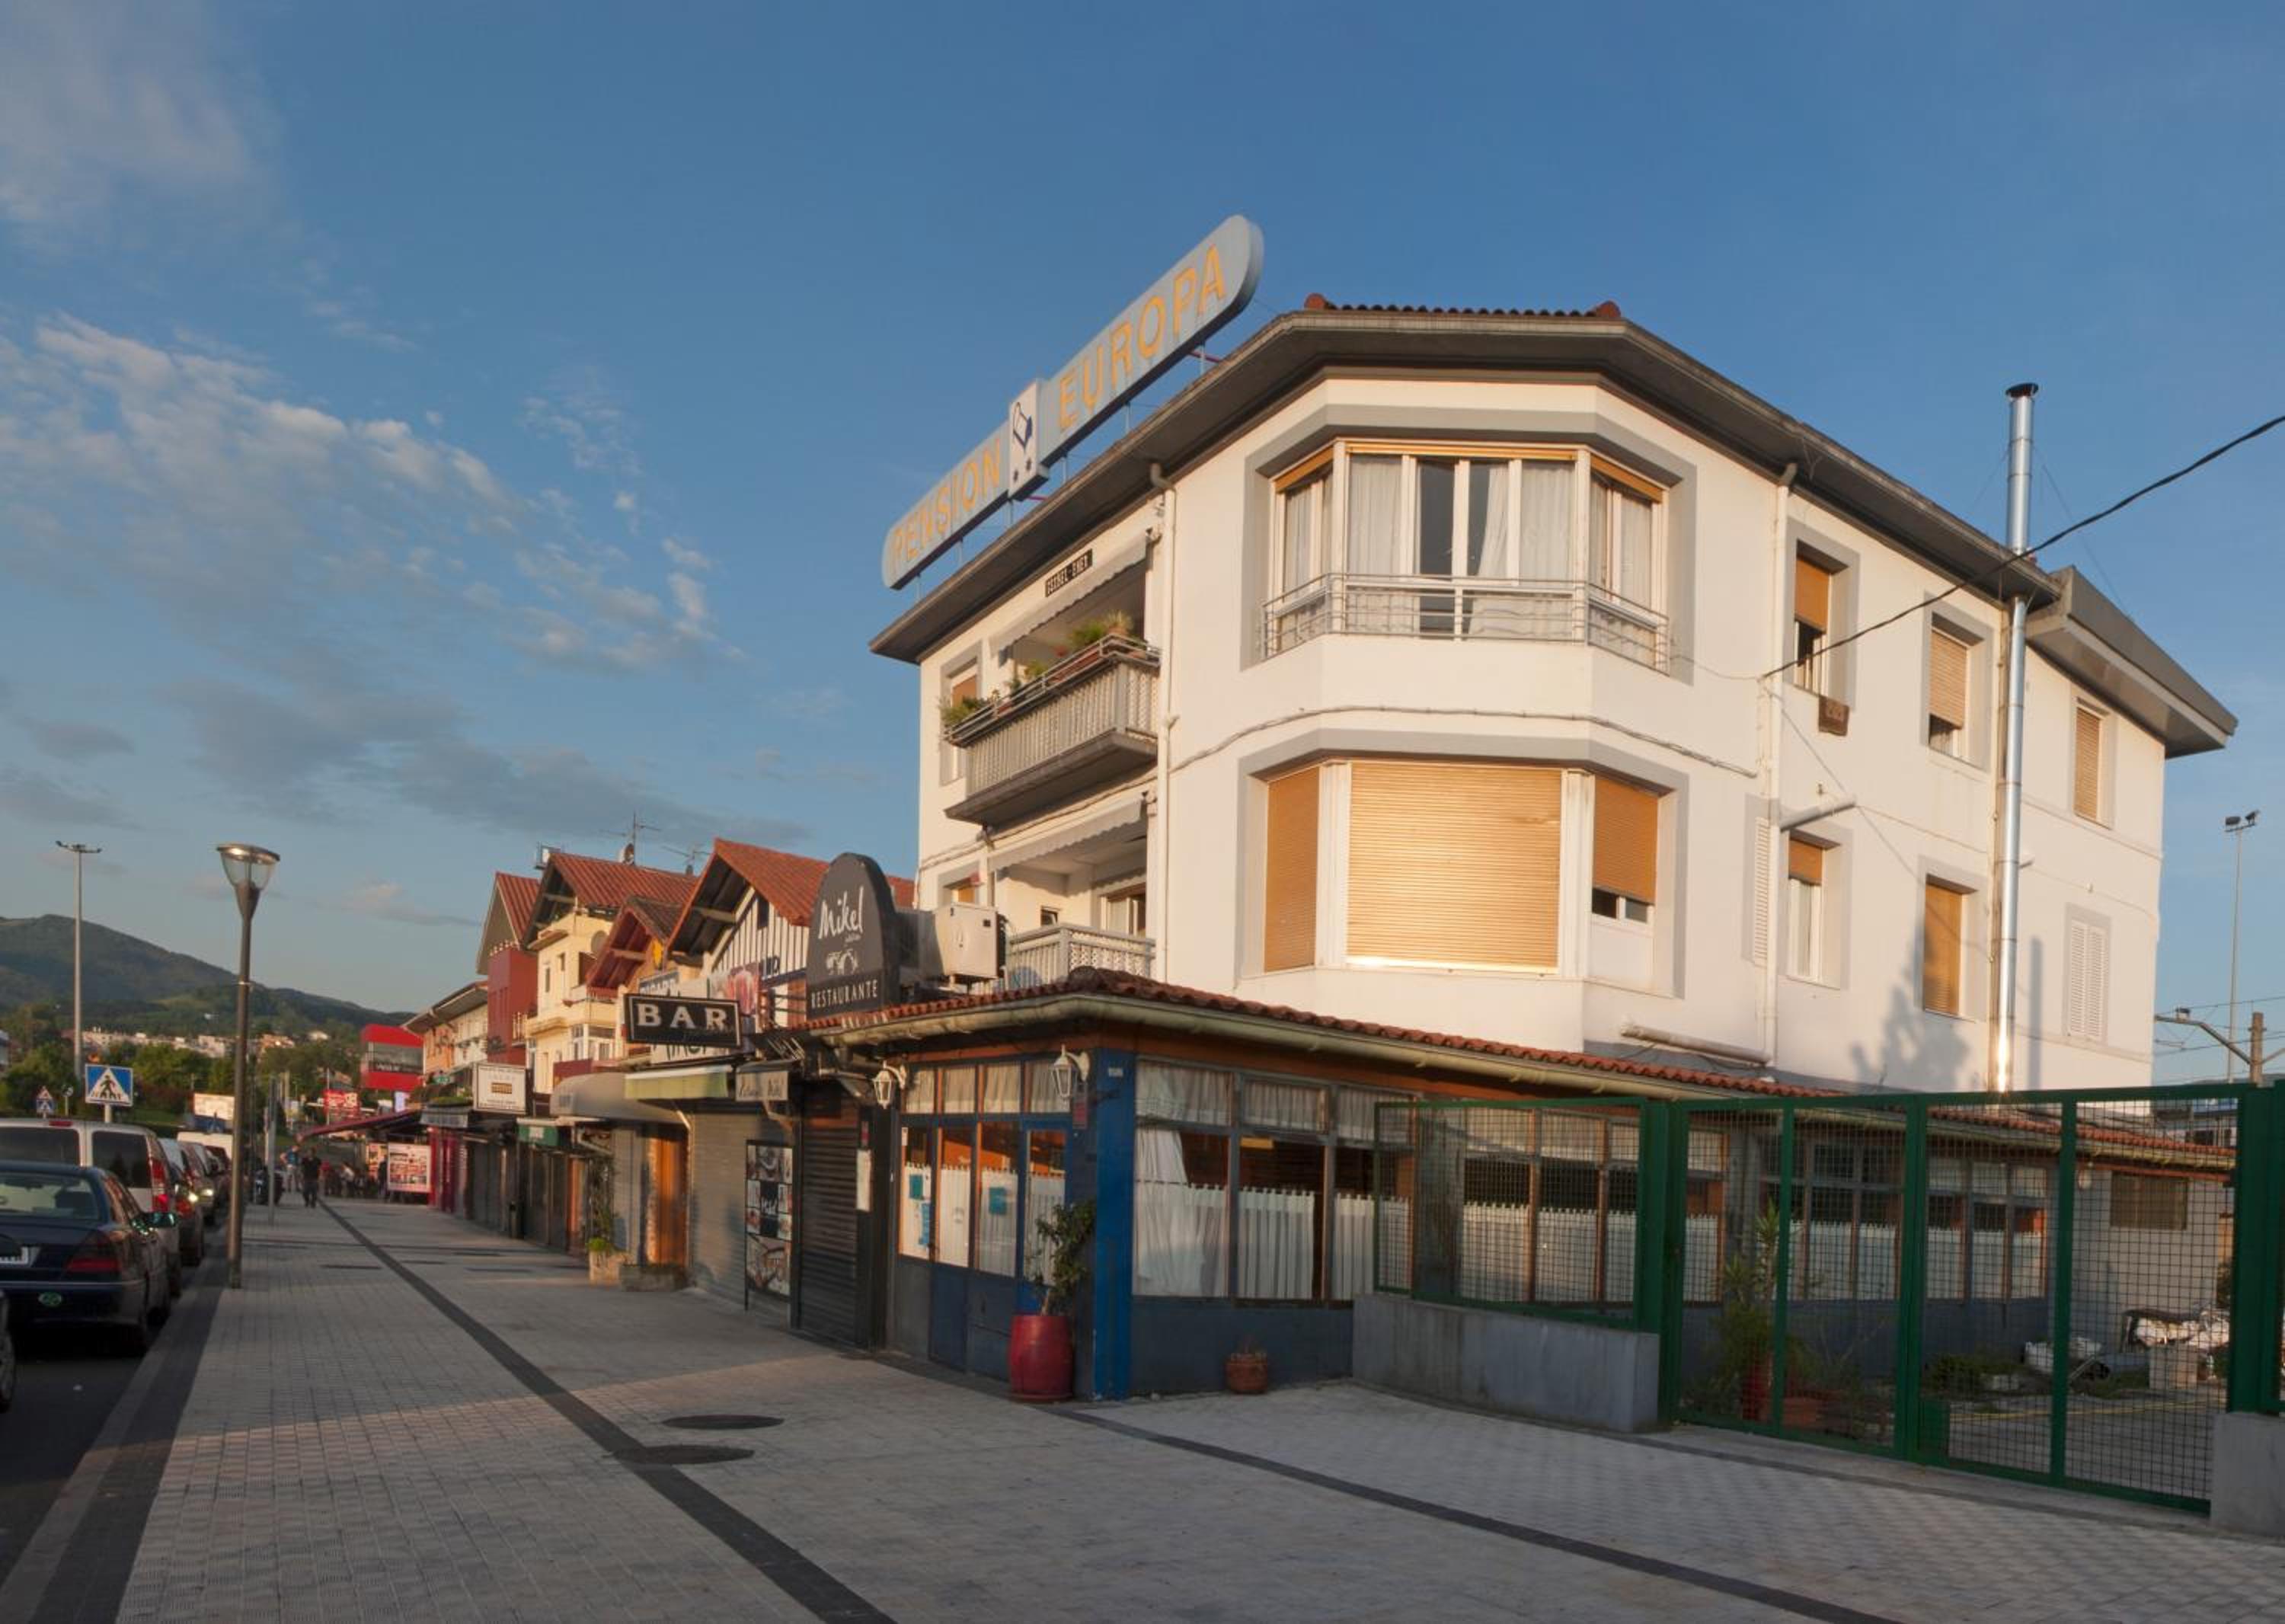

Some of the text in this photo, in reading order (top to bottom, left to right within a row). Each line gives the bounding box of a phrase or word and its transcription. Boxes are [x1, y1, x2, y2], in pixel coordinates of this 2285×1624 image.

[889, 242, 1227, 577] PENSION EUROPA
[818, 886, 864, 940] Mikel
[810, 979, 879, 1009] RESTAURANTE
[636, 1002, 729, 1031] BAR
